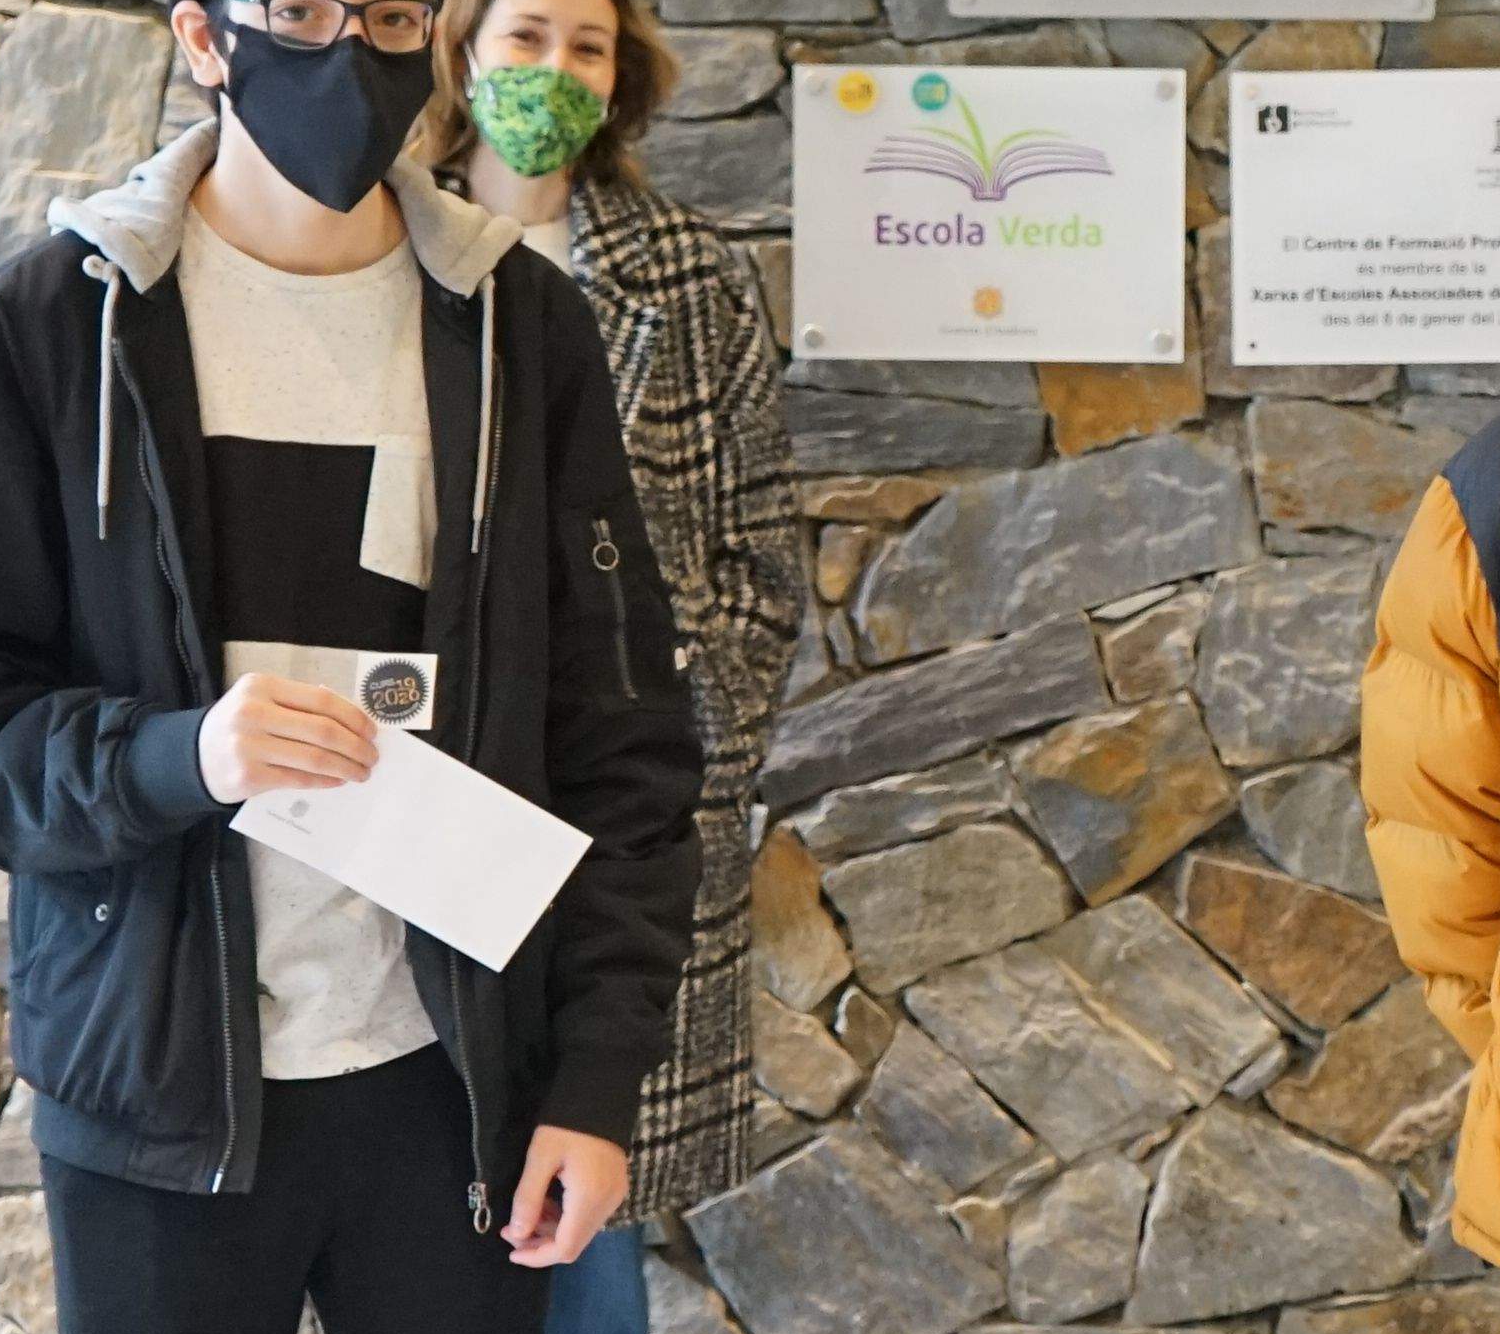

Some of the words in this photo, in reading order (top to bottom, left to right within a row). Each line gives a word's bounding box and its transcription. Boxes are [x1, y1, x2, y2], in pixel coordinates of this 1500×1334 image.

[875, 212, 985, 247] Escola
[998, 214, 1104, 247] Verda
[1304, 235, 1358, 251] Centre
[1363, 235, 1383, 250] de
[1387, 234, 1466, 250] Formació
[1380, 261, 1445, 275] membre
[1449, 261, 1470, 274] de
[1389, 286, 1485, 301] Associades
